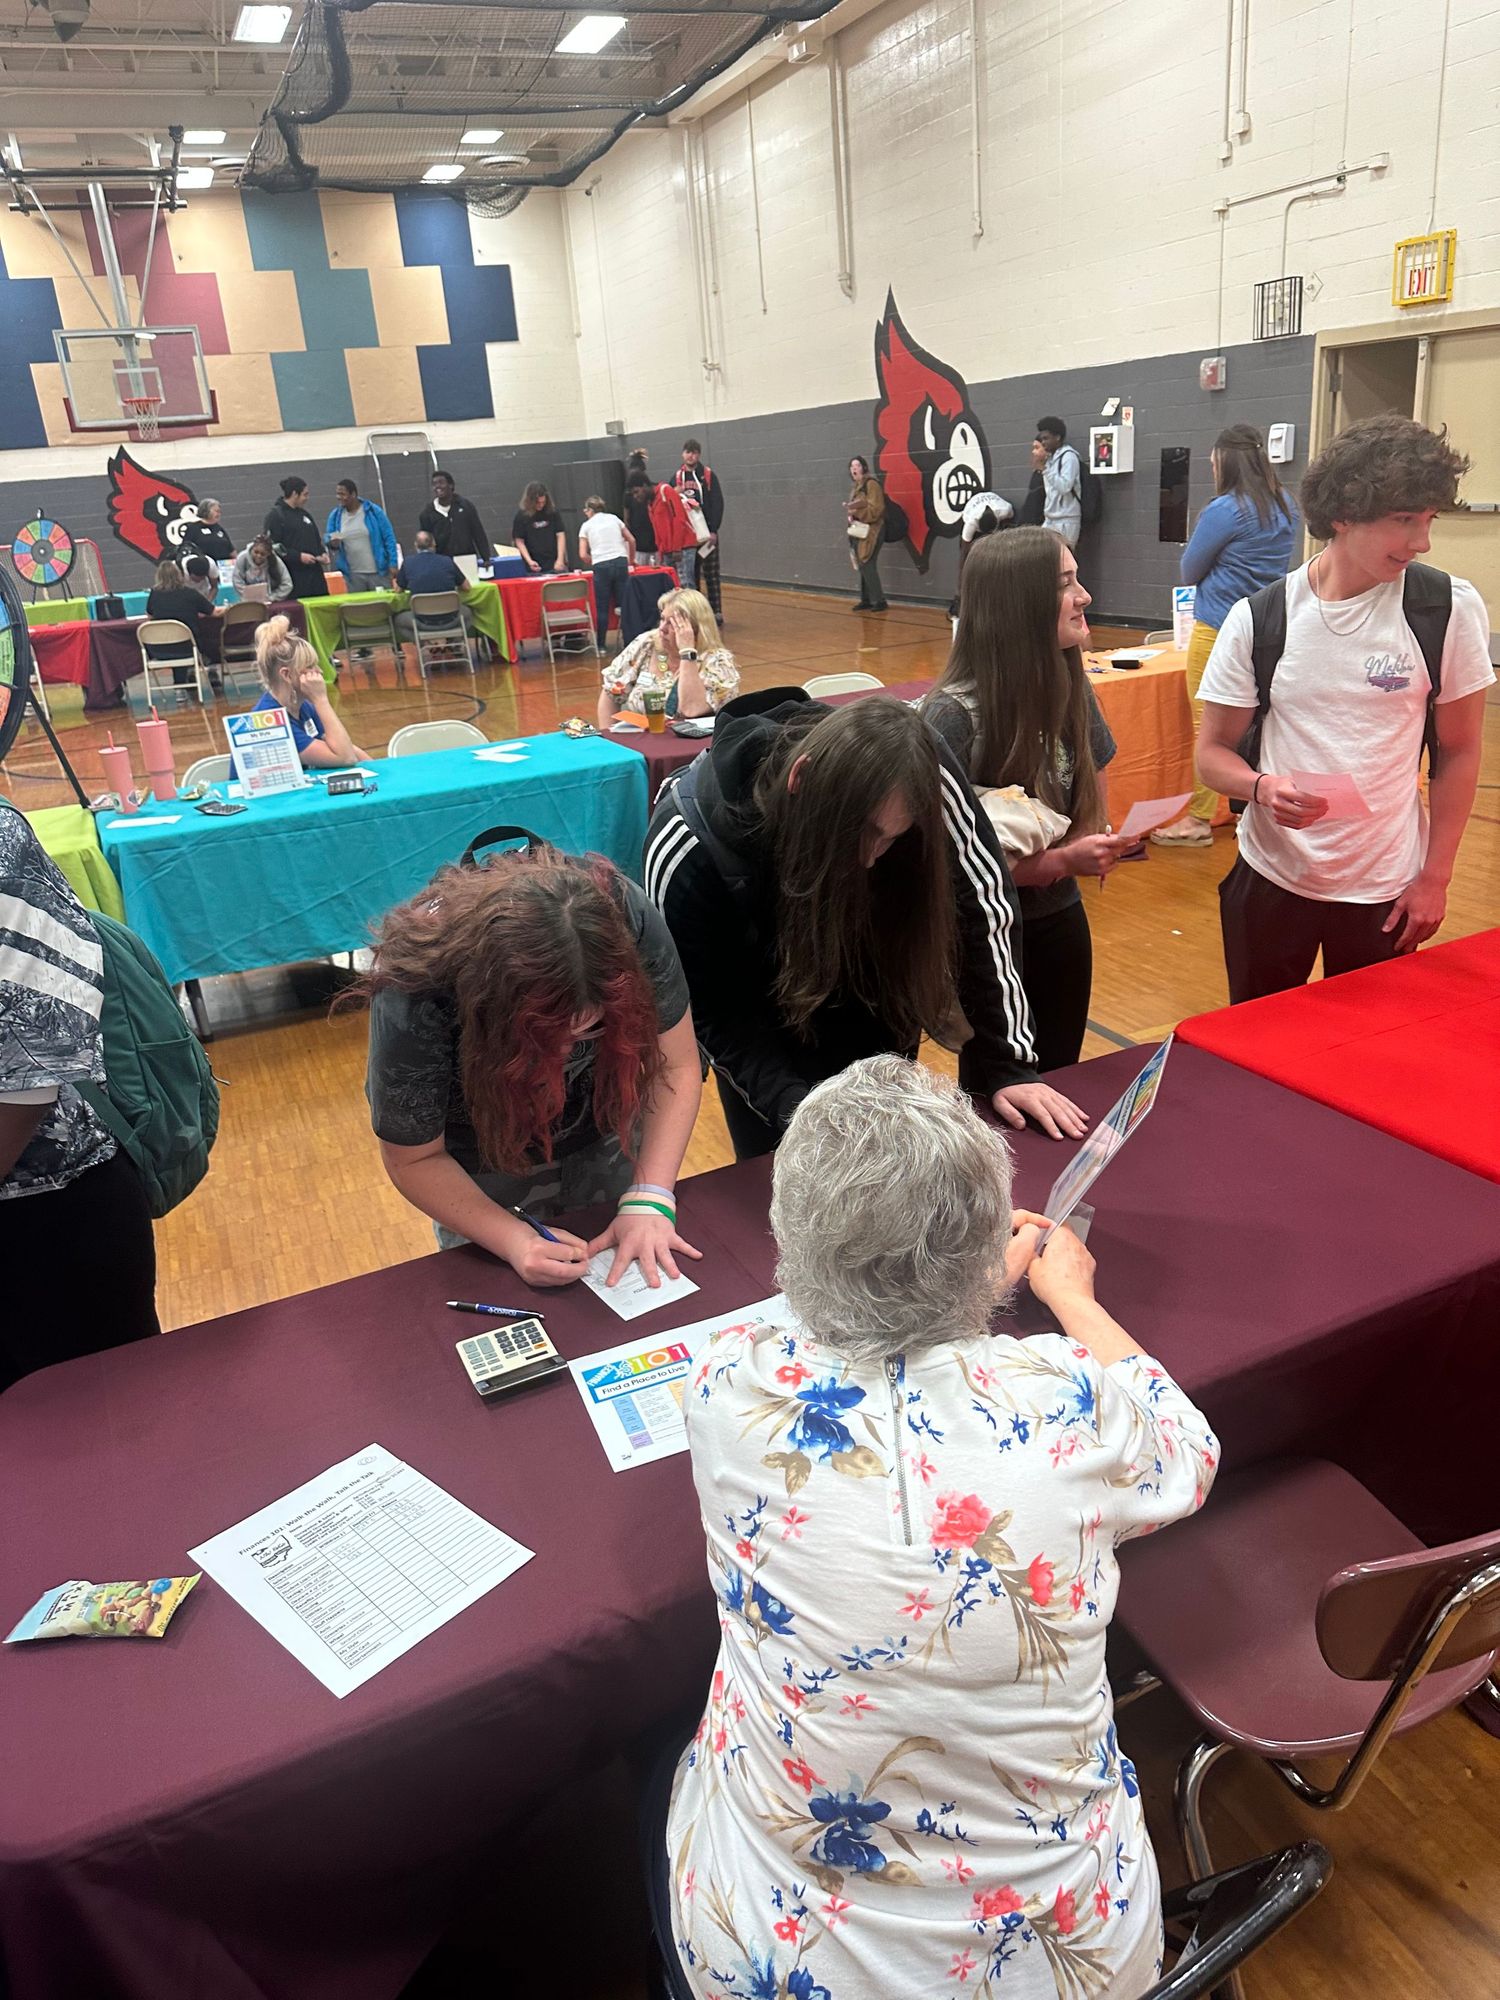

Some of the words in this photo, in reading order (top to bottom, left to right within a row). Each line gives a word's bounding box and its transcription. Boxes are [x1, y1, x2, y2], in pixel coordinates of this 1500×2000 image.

[631, 1346, 687, 1372] 101
[602, 1384, 622, 1395] Find
[631, 1374, 657, 1386] Place
[669, 1365, 685, 1375] Live
[238, 1535, 270, 1555] Finances
[269, 1525, 286, 1536] 101:
[285, 1514, 304, 1526] Walk
[303, 1507, 316, 1515] the
[315, 1495, 336, 1508] Walk,
[335, 1486, 349, 1494] Talk
[348, 1478, 360, 1486] the
[360, 1471, 374, 1479] Talk
[267, 1563, 293, 1580] Description
[295, 1596, 314, 1609] Benefits
[343, 1649, 358, 1660] Credit
[348, 1641, 381, 1666] Entertainment
